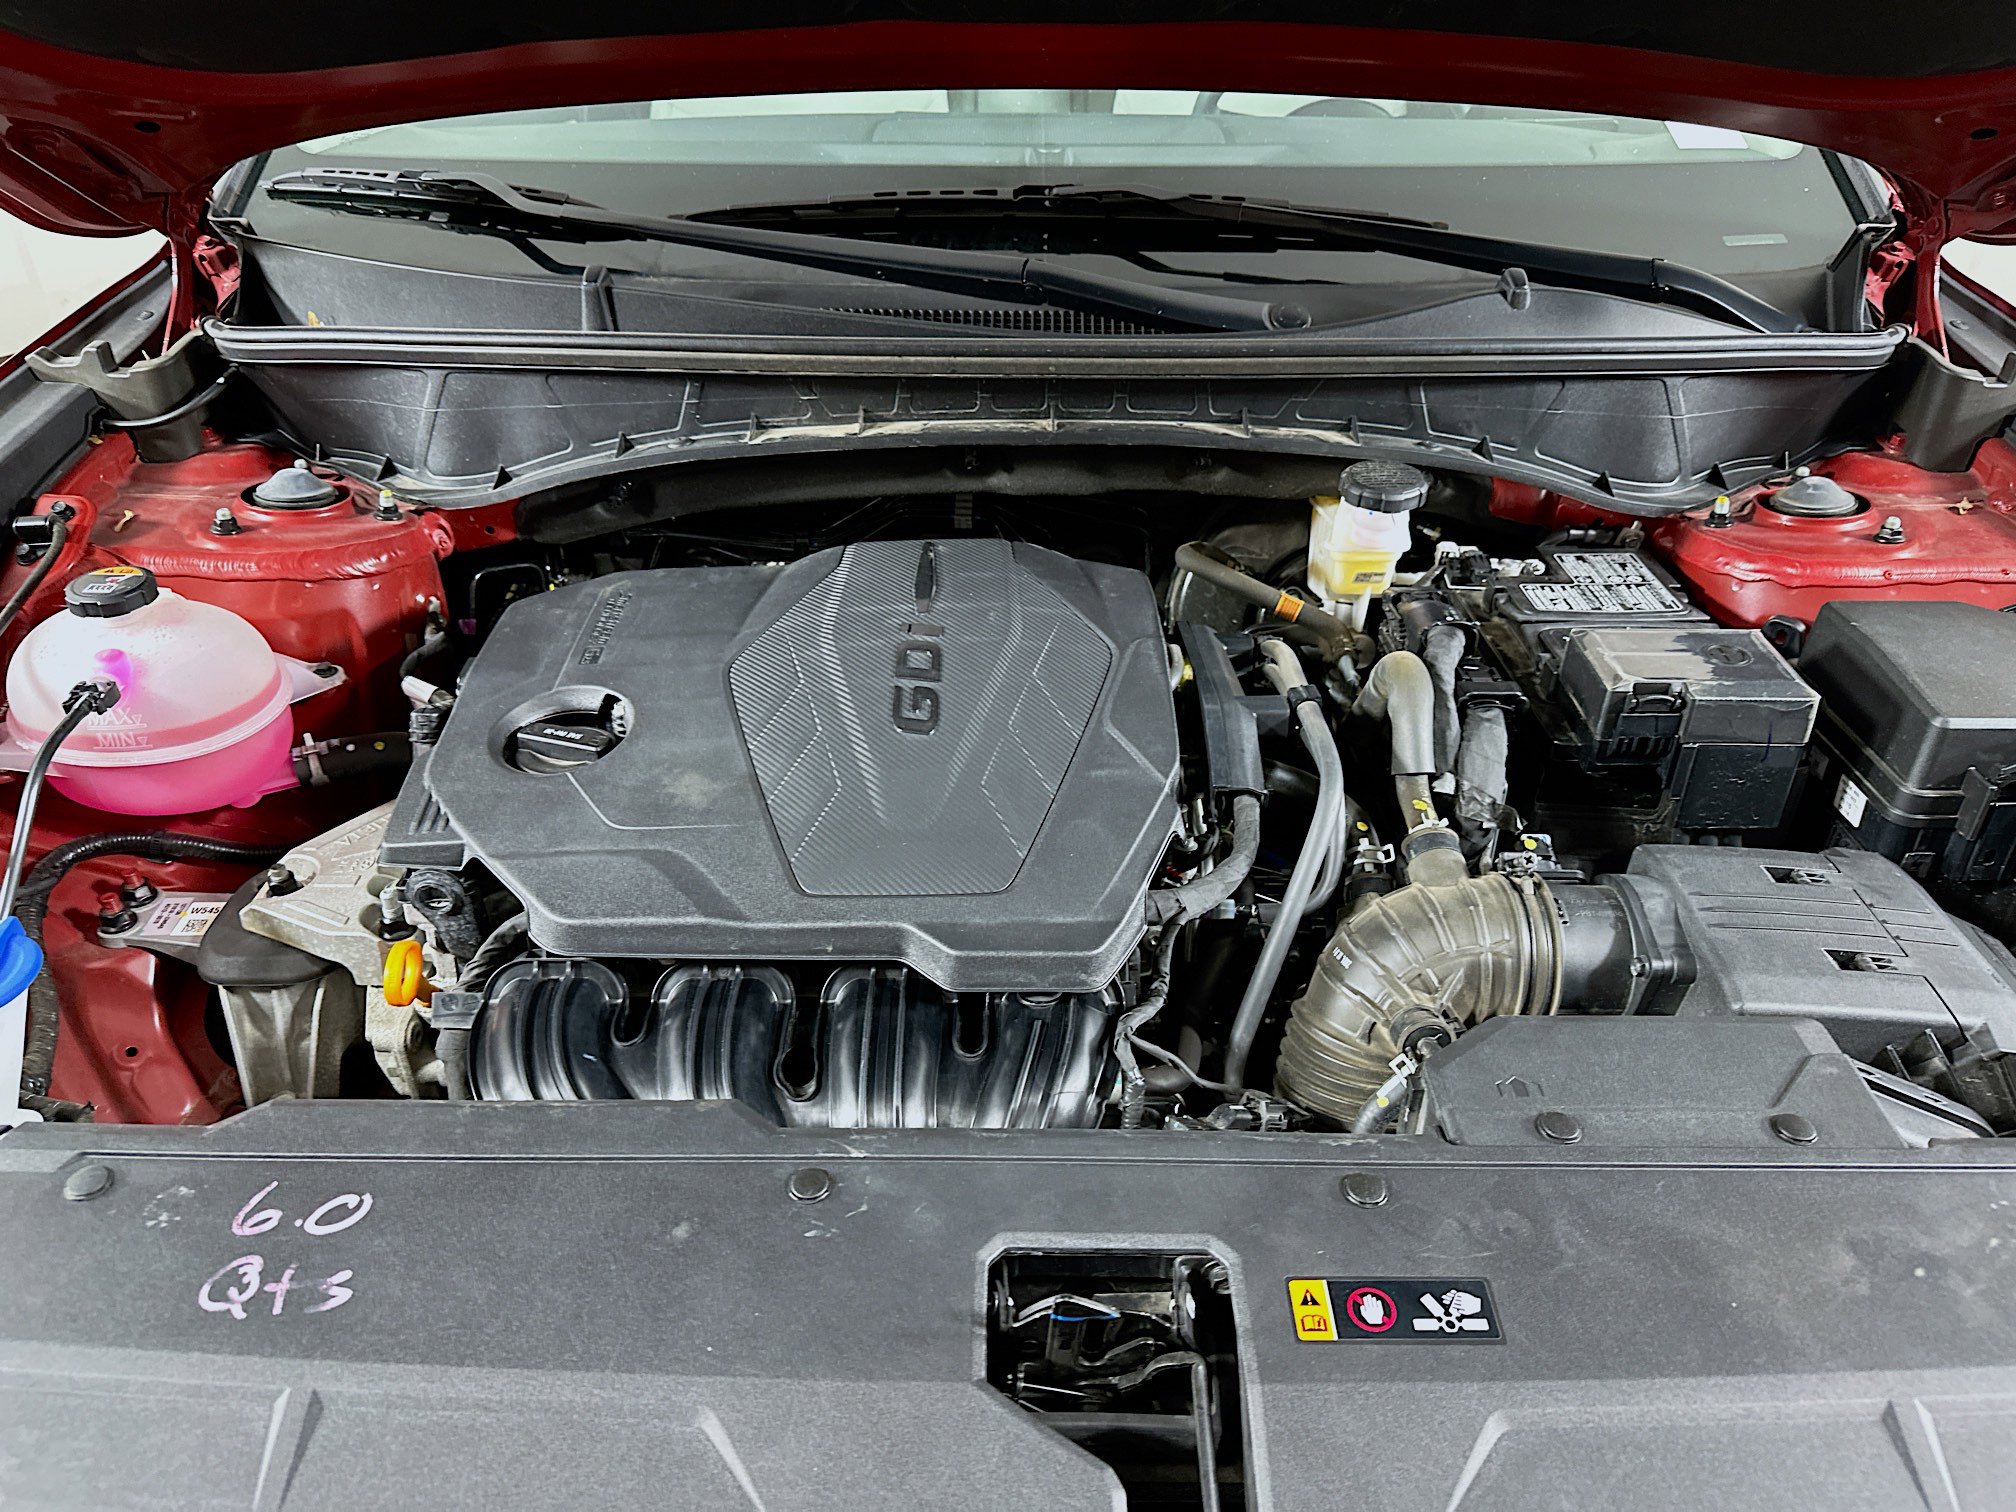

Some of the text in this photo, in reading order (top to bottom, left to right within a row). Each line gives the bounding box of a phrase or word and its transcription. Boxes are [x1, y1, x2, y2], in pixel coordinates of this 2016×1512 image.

[96, 731, 137, 747] MIN
[190, 906, 221, 915] W545
[231, 1180, 374, 1236] 6.0
[198, 1254, 354, 1320] Qts
